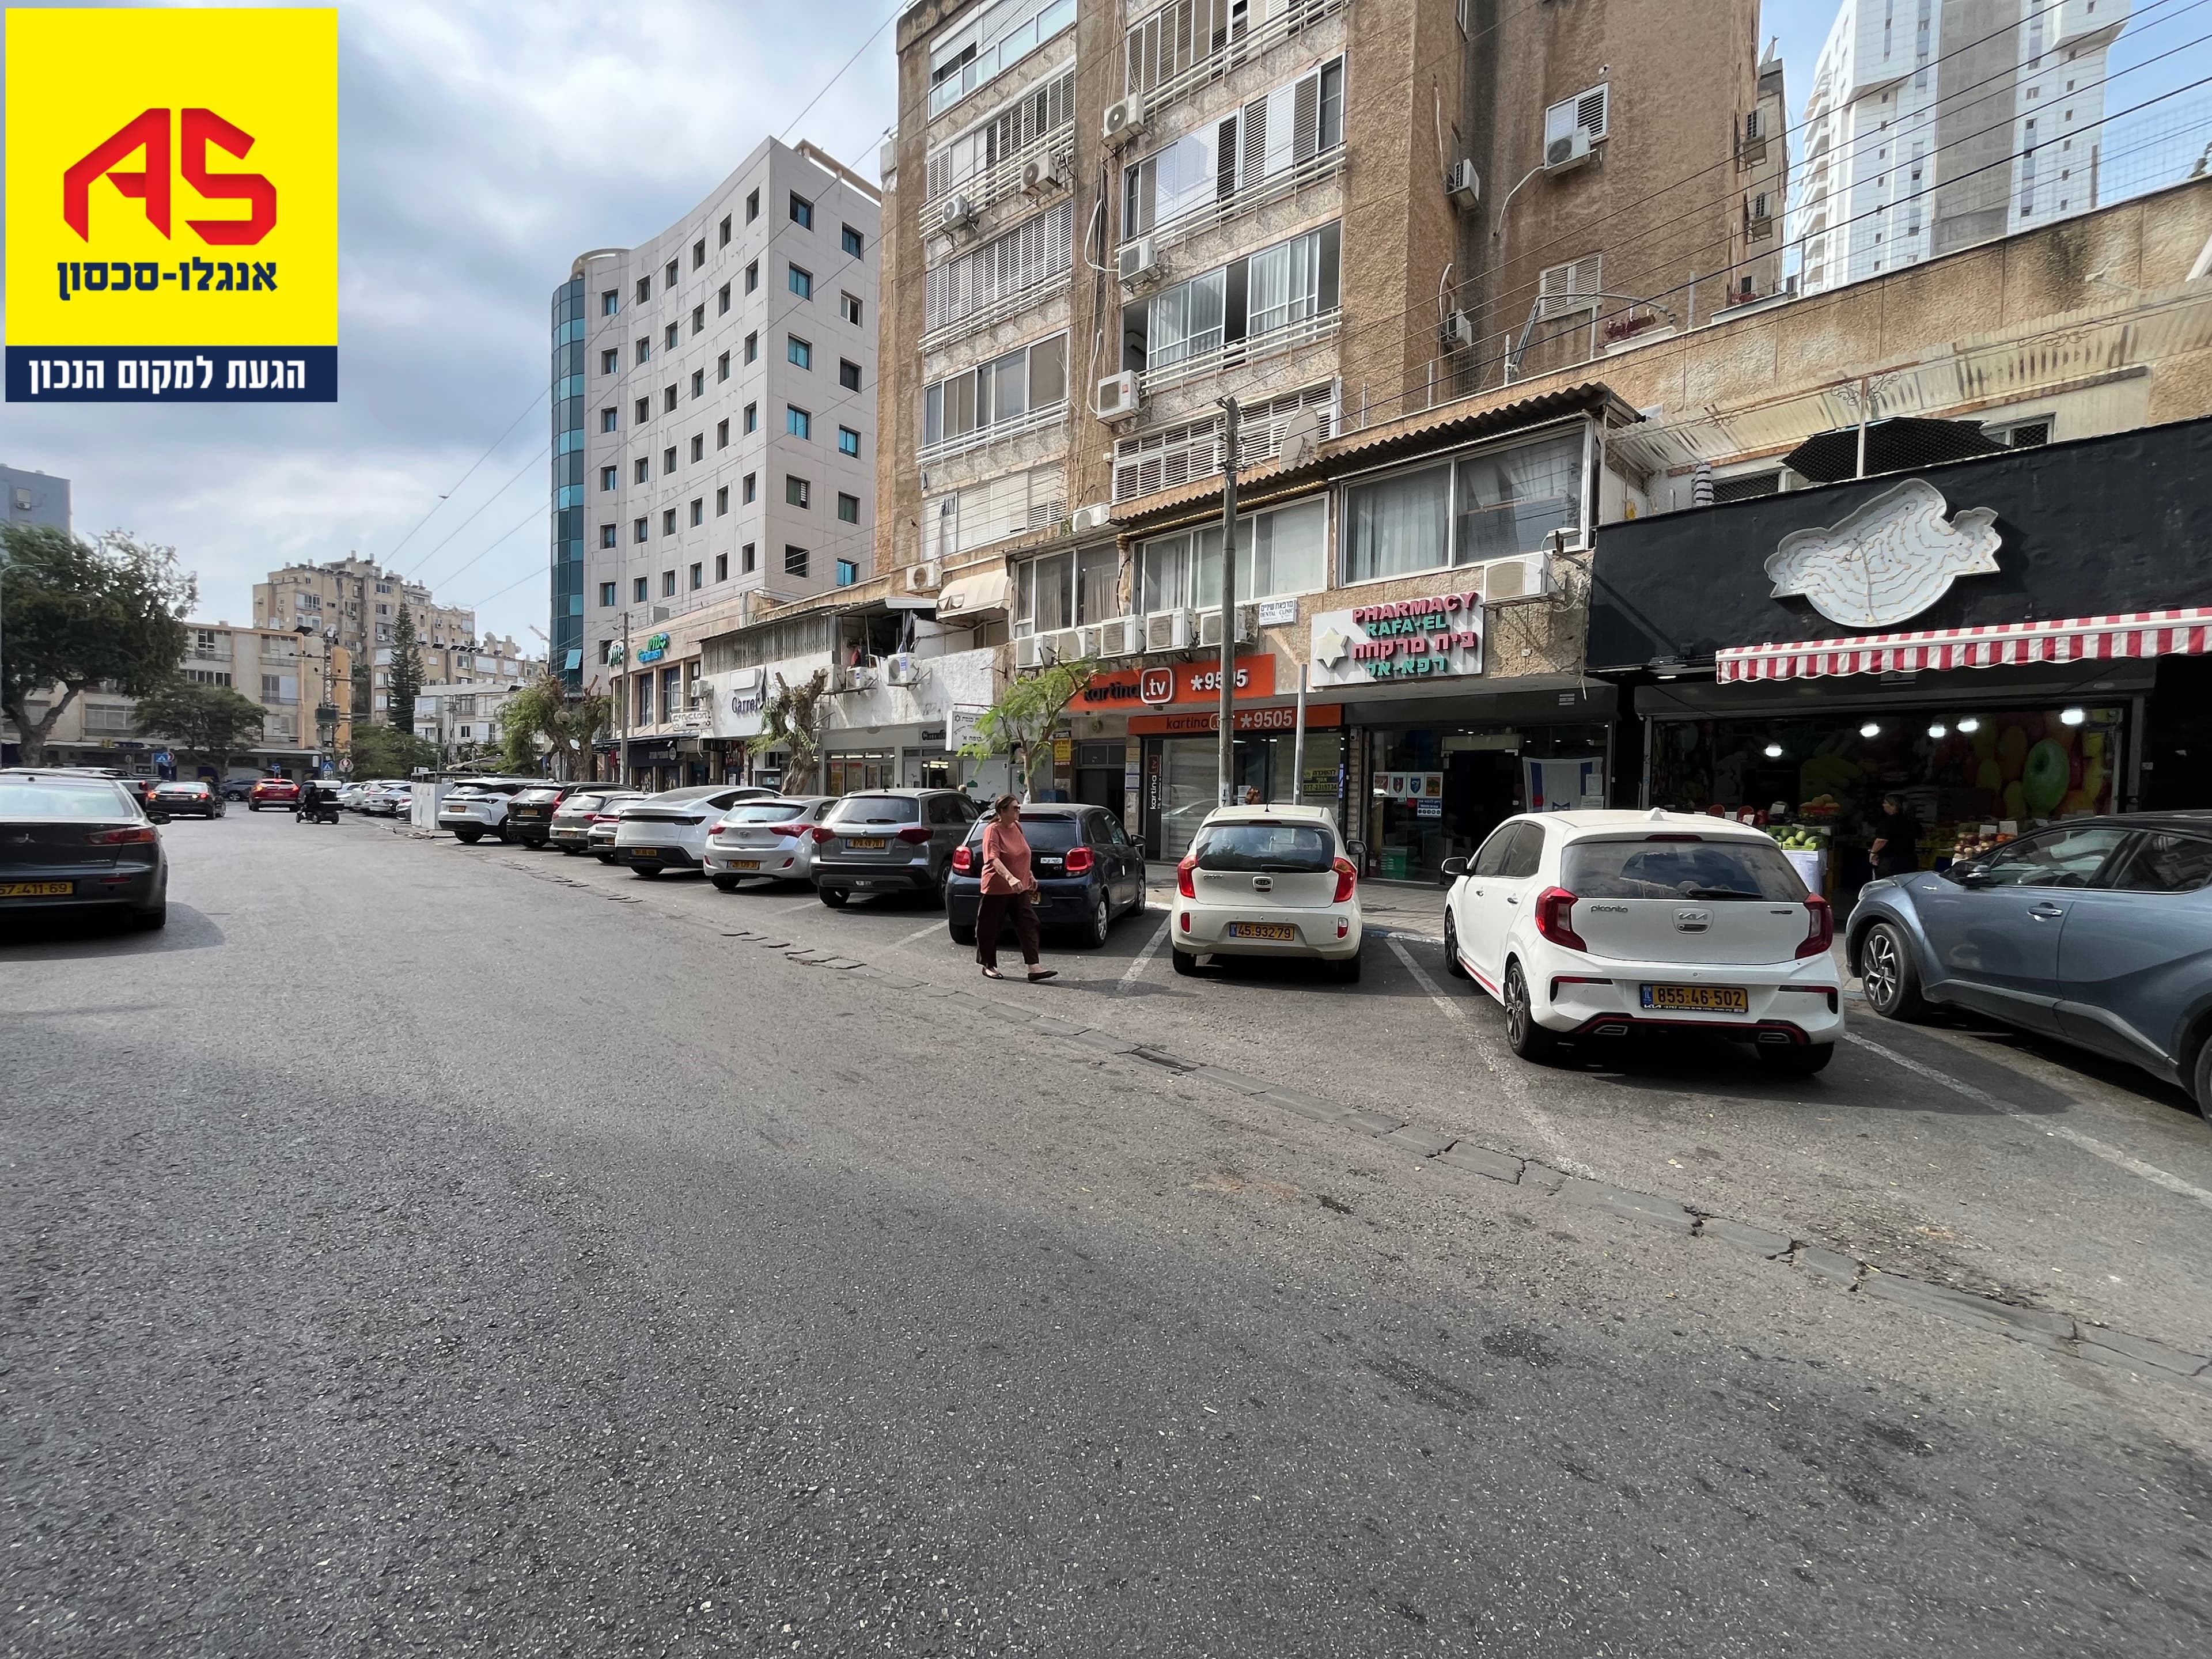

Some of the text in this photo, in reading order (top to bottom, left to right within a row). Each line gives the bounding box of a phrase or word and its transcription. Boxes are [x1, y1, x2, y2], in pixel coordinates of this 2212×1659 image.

[1353, 592, 1478, 623] PHARMACY
[1366, 615, 1448, 637] RAFA-EL
[1434, 631, 1476, 651] בית
[1365, 657, 1448, 677] רפא-אל
[1191, 669, 1248, 691] 955
[1166, 714, 1209, 730] kartina
[1590, 904, 1628, 913] picanto
